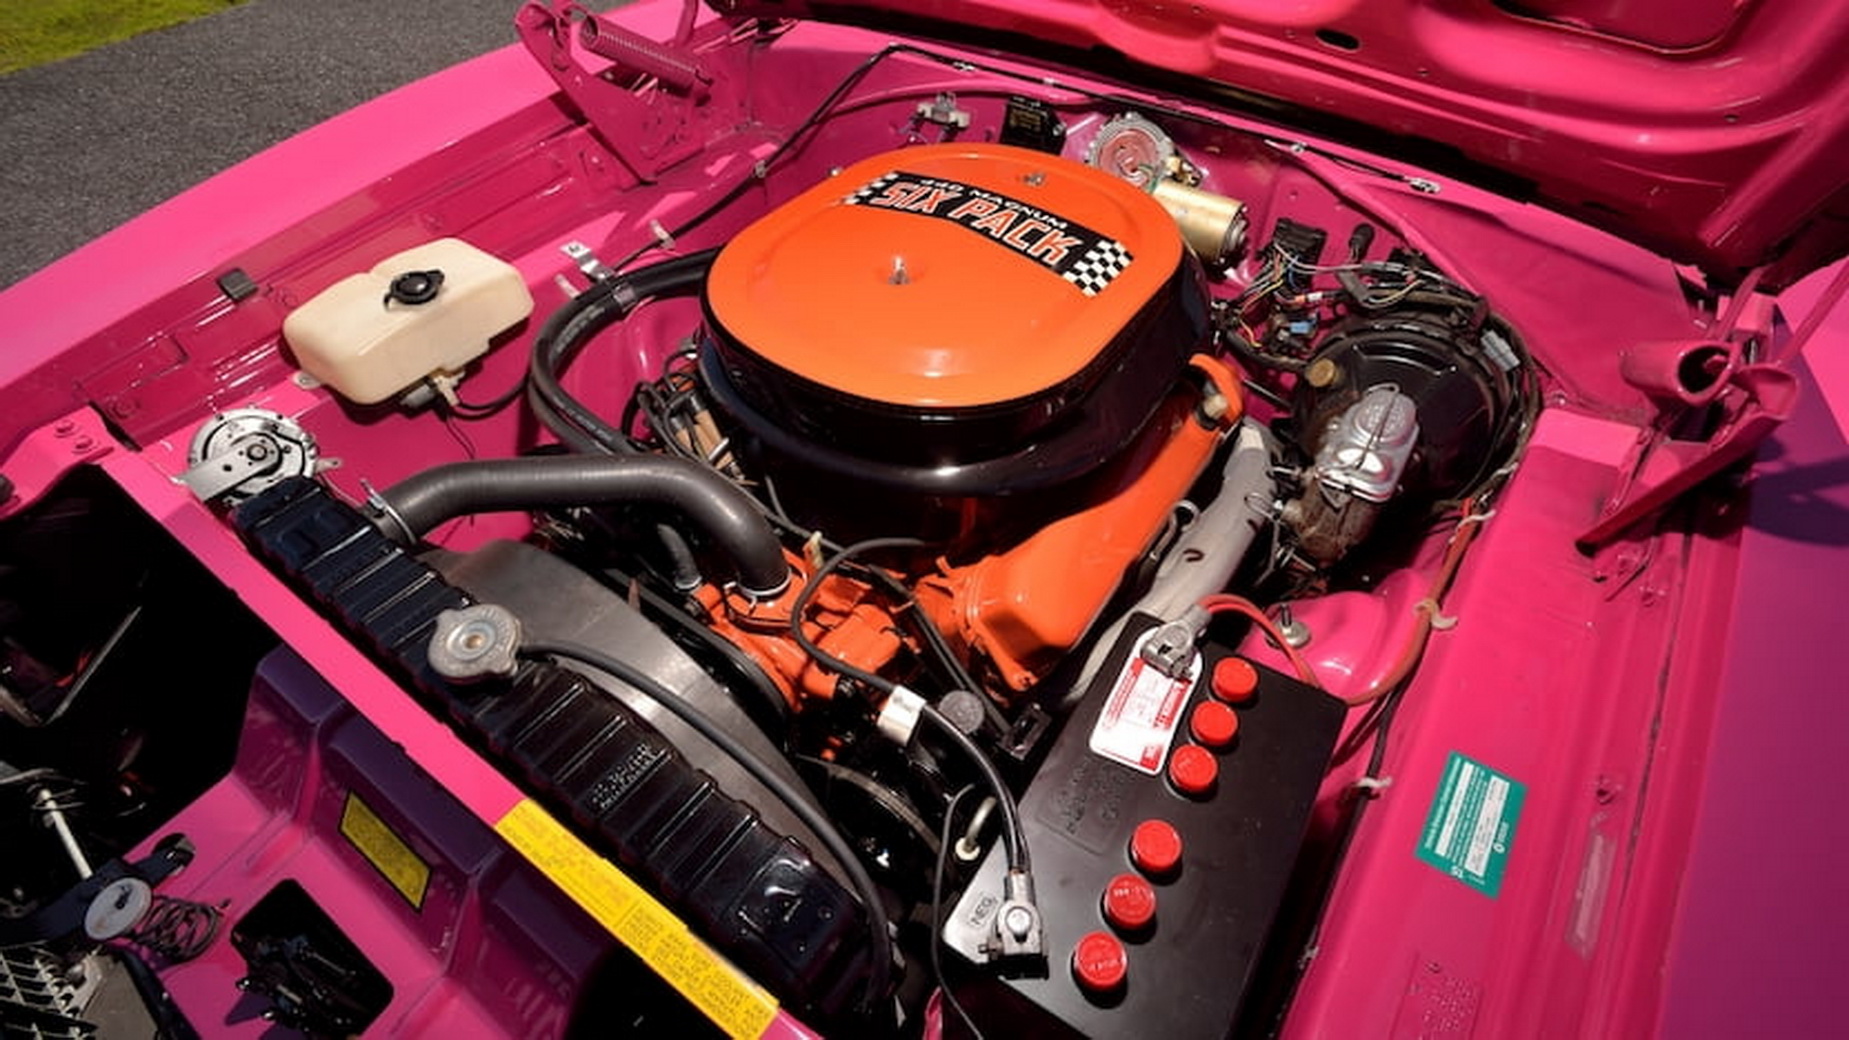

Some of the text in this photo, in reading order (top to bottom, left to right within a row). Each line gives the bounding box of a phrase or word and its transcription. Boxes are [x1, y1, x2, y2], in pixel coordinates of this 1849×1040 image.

[869, 181, 1083, 266] SIX PACK
[968, 189, 1068, 229] MAGNUM
